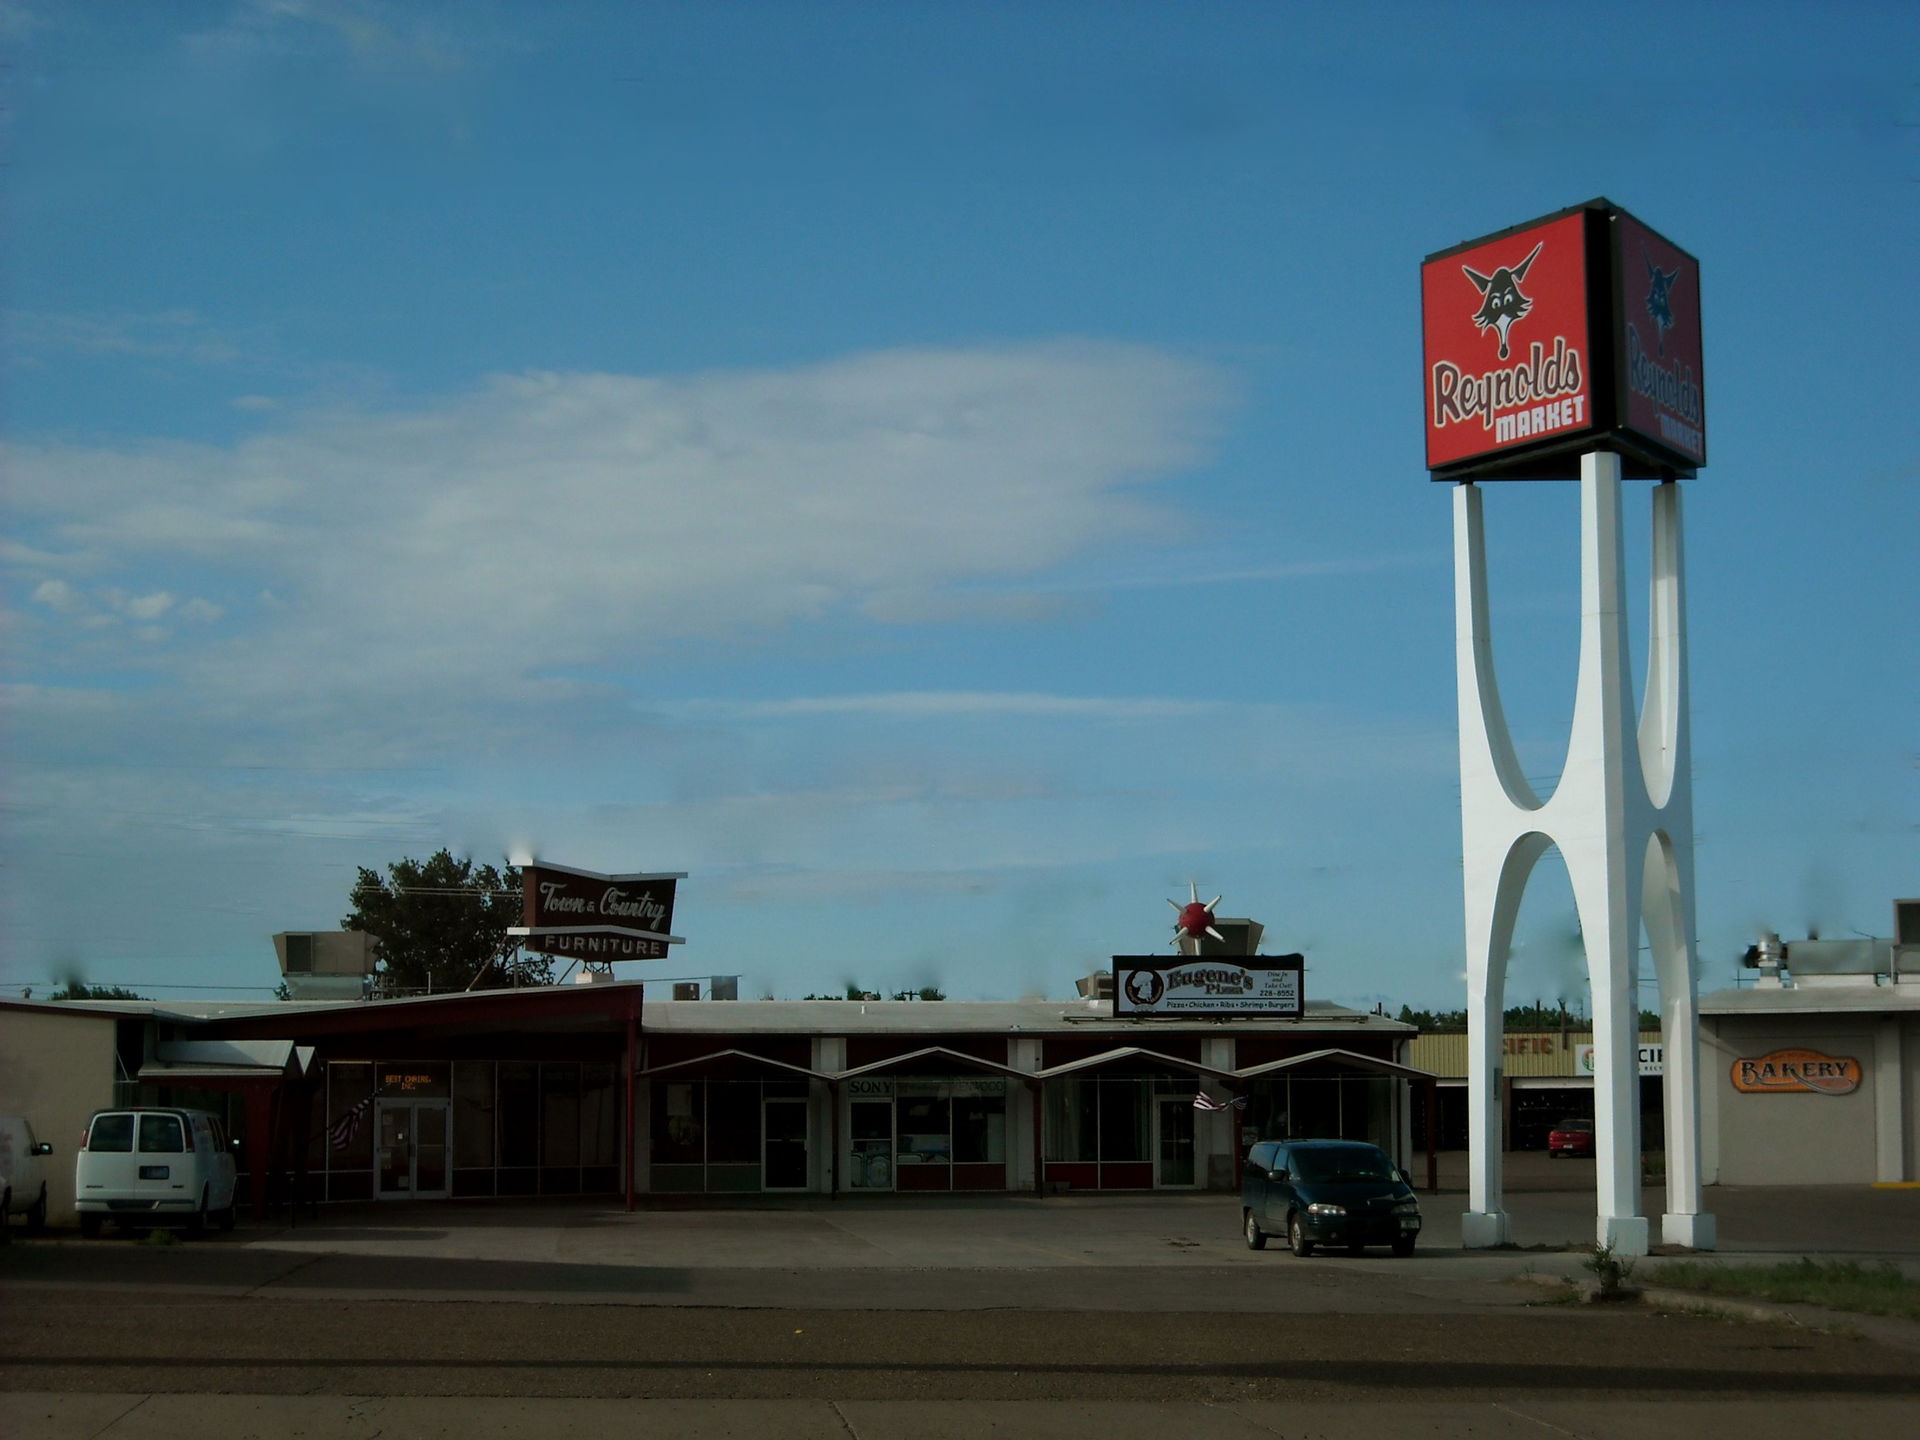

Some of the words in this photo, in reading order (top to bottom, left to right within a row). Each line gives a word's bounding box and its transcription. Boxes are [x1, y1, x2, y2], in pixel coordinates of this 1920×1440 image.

[1433, 336, 1582, 431] Reynolds
[1495, 395, 1584, 443] MARKET
[540, 882, 586, 913] Town
[587, 903, 595, 913] &
[600, 886, 666, 931] Country
[544, 935, 661, 955] FURNITURE
[1166, 968, 1254, 991] Eugene's
[1166, 1001, 1185, 1009] Pizza
[1188, 1001, 1215, 1009] Chicken
[1219, 1001, 1235, 1009] Ribs
[1239, 1001, 1264, 1010] Shrimp
[1268, 1001, 1295, 1010] Burgers
[1741, 1061, 1849, 1078] BAKERY
[850, 1080, 892, 1094] SONY
